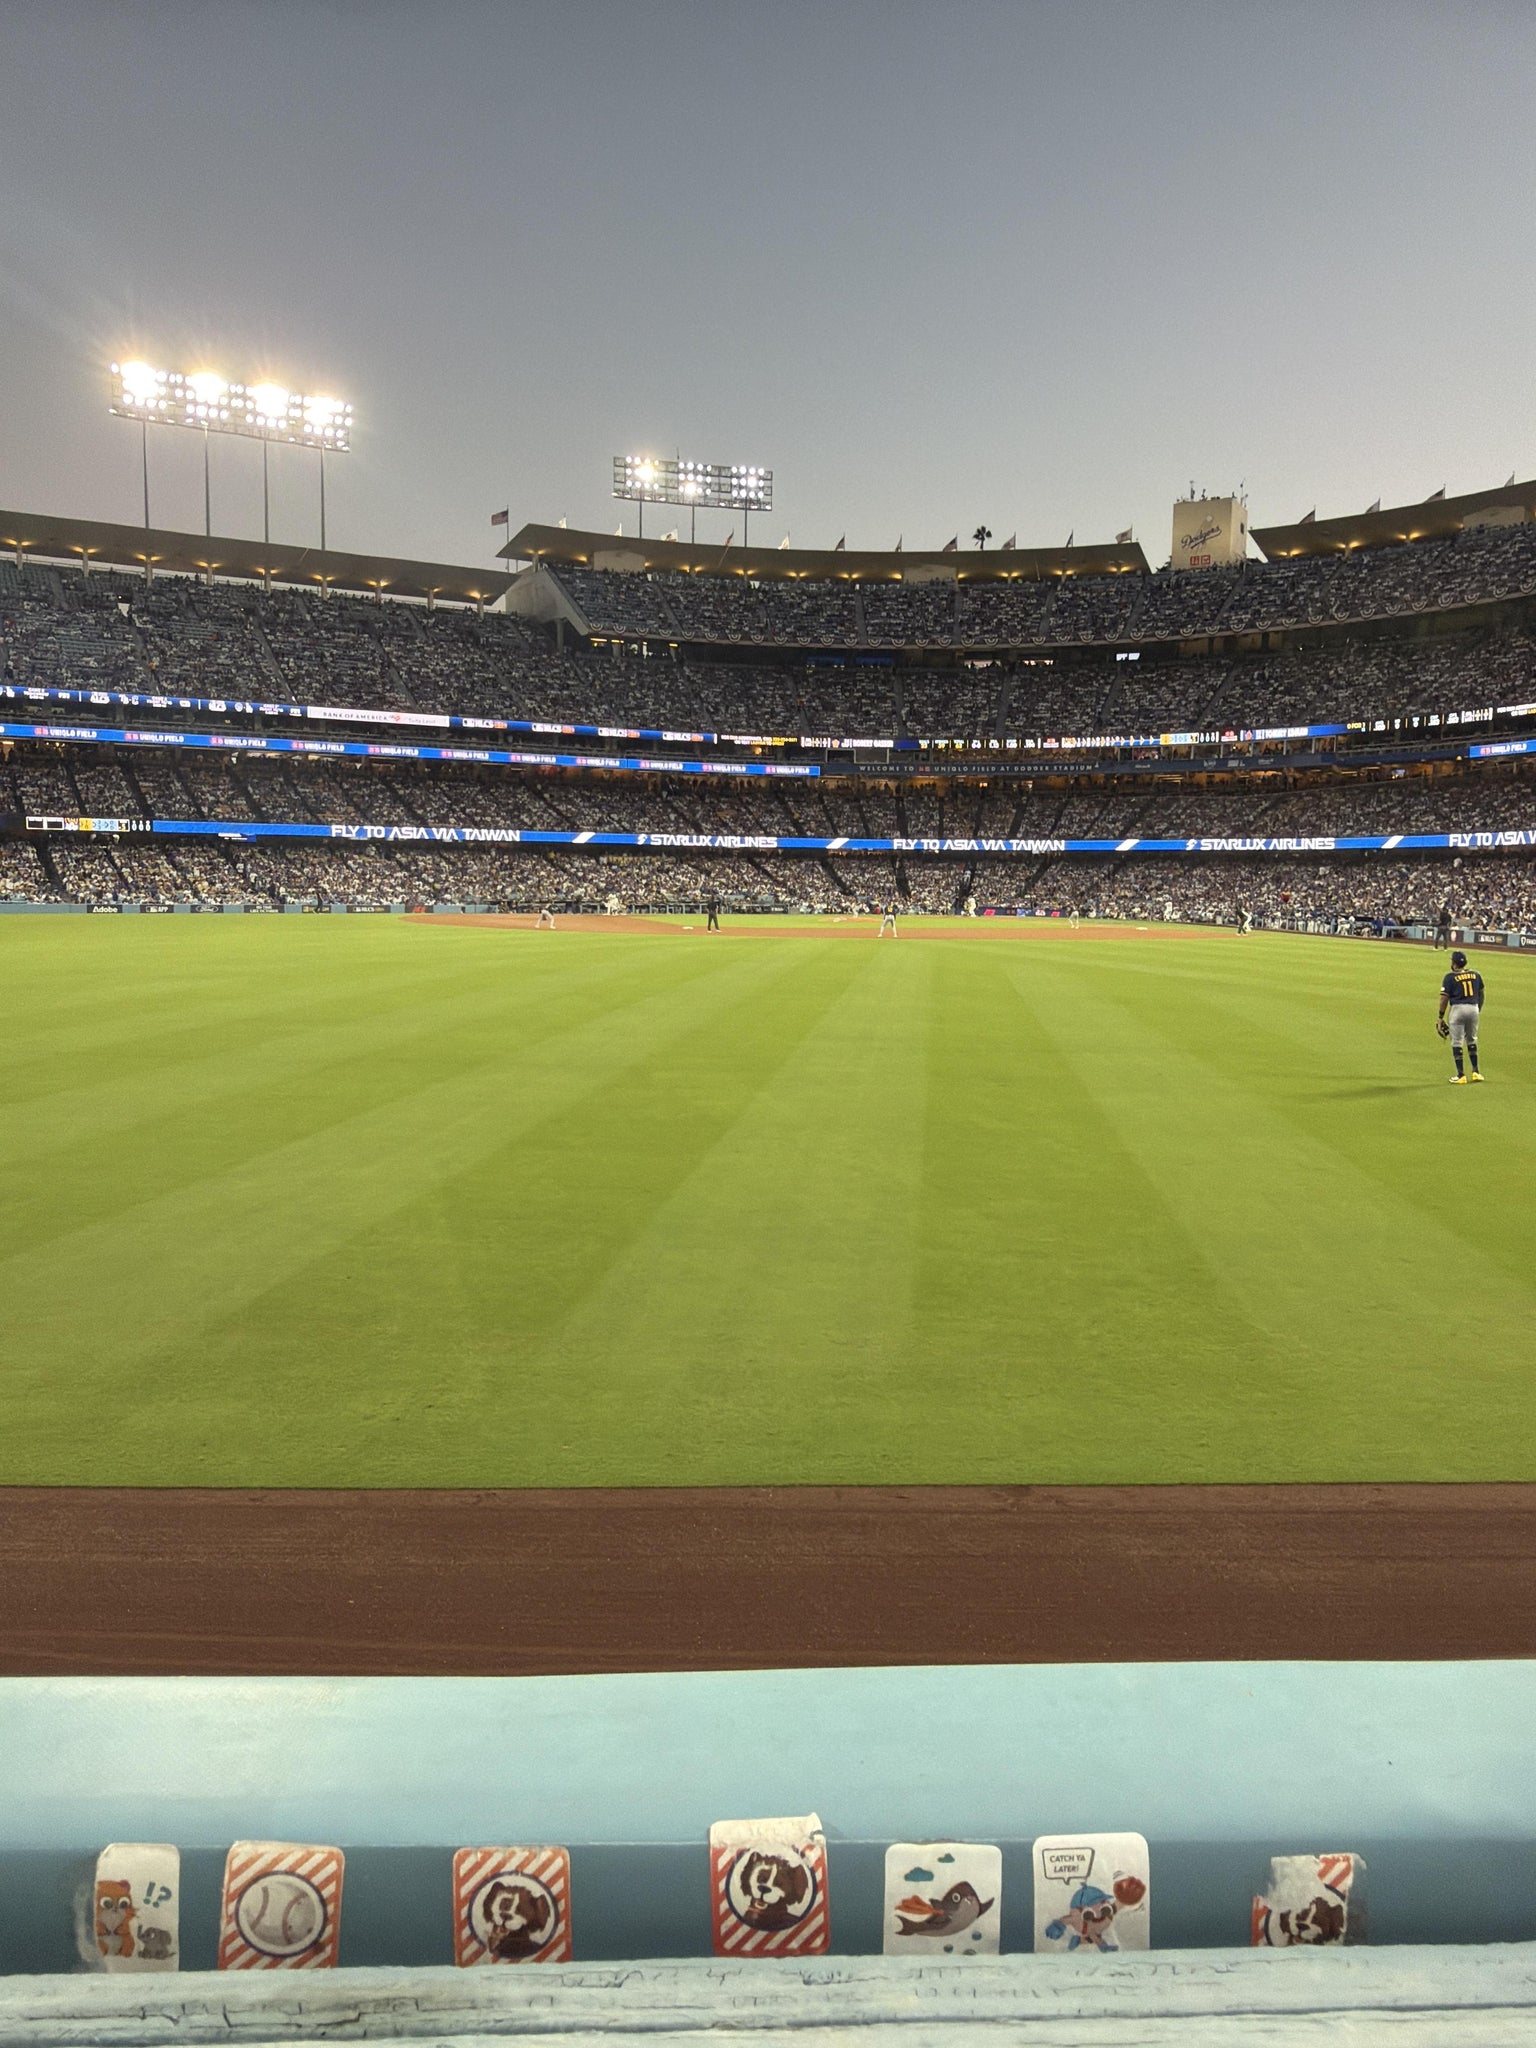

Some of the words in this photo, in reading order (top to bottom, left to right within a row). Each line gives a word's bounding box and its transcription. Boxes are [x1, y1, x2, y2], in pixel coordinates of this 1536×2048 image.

[1181, 525, 1222, 549] Dodgers
[356, 713, 387, 721] AMERICA
[50, 729, 75, 737] UNIQLO
[76, 730, 97, 738] FIELD
[224, 738, 247, 746] UNIQLO
[248, 739, 266, 747] FIELD
[327, 744, 344, 752] FIELD
[381, 746, 401, 754] UNIQLO
[402, 747, 418, 755] FIELD
[453, 751, 472, 759] UNIQLO
[331, 825, 360, 838] FLY
[364, 825, 385, 839] TO
[392, 826, 429, 840] ASIA
[432, 827, 458, 840] VIA
[461, 828, 520, 842] TAIWAN
[650, 834, 713, 846] STARLUX
[714, 835, 777, 848] AIRLINES
[1200, 838, 1266, 850] STARLUX
[1268, 837, 1335, 850] AIRLINES
[1449, 833, 1473, 847] FLY
[1474, 832, 1492, 846] TO
[1495, 831, 1526, 846] ASIA
[893, 839, 917, 850] FLY
[920, 839, 940, 850] TO
[943, 839, 978, 850] ASIA
[982, 840, 1006, 851] VIA
[1009, 840, 1065, 851] TAIWAN
[1462, 981, 1474, 997] 11
[1049, 1855, 1075, 1863] CATCH
[1076, 1854, 1086, 1862] YA
[1053, 1864, 1079, 1873] LATER!
